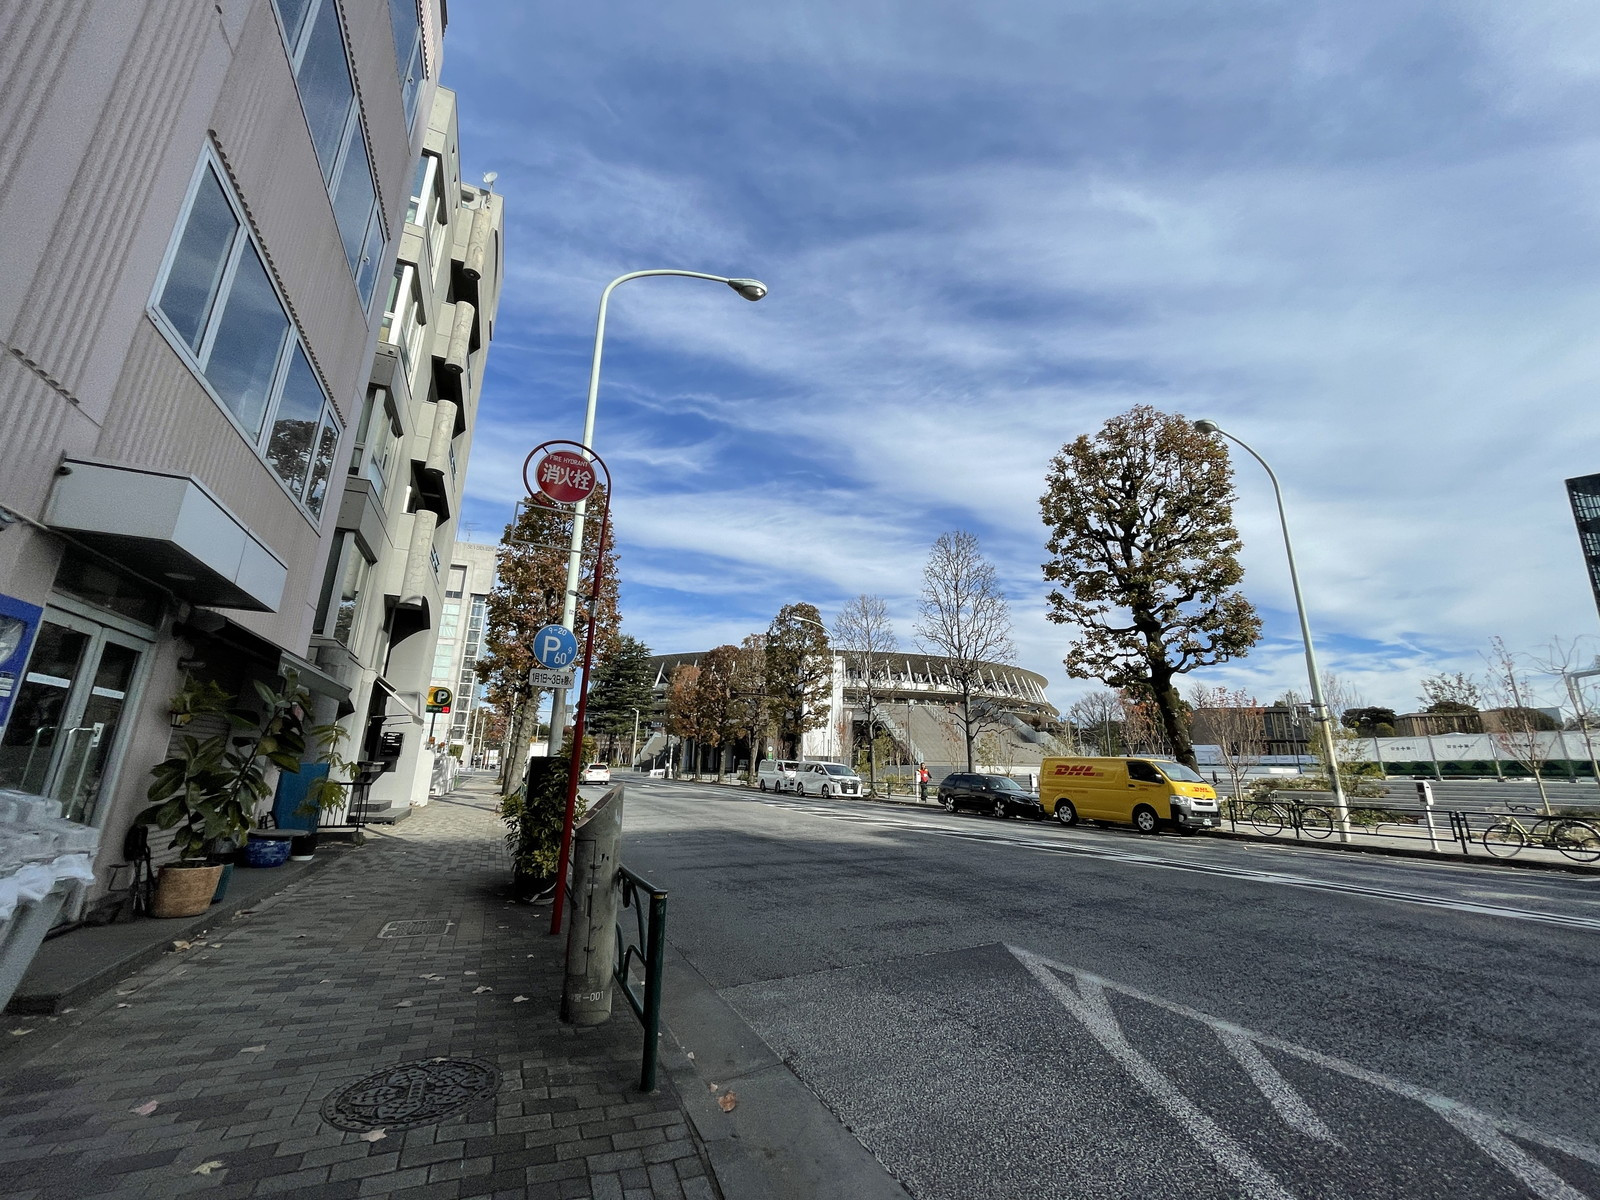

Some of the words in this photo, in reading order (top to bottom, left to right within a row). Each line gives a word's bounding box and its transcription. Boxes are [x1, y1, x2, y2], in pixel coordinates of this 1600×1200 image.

[550, 455, 562, 463] FIRE
[563, 457, 588, 467] HYDRANT
[541, 462, 592, 490] 消火栓
[548, 627, 568, 636] 9-20
[542, 635, 562, 663] P
[553, 652, 567, 665] 60
[436, 690, 448, 703] P
[1054, 764, 1096, 777] DHL
